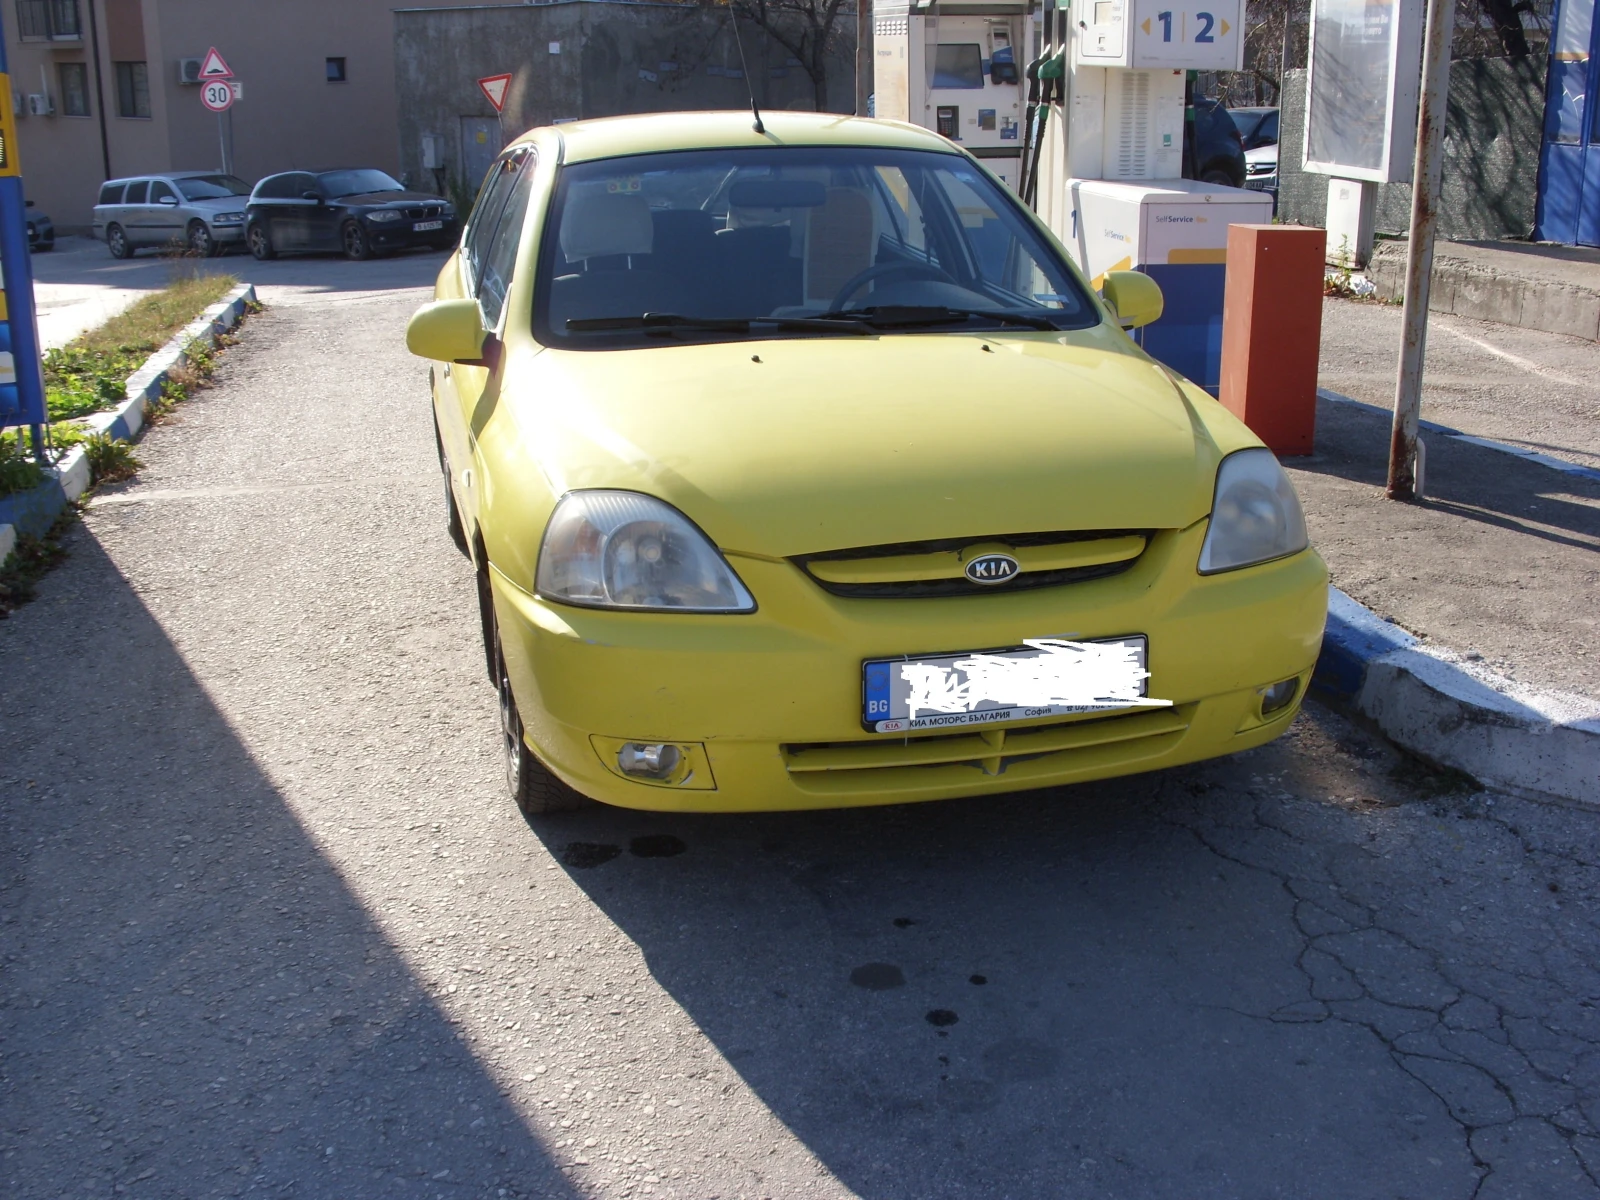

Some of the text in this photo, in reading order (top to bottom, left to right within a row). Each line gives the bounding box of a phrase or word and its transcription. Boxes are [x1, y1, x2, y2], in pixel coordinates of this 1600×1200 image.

[1158, 11, 1214, 43] 1 2
[208, 87, 227, 103] 30
[975, 560, 1011, 577] KIA
[868, 699, 888, 714] BG
[1024, 707, 1052, 717] София
[909, 711, 1011, 728] КИА МОТОРС БЪЛГАРИЯ
